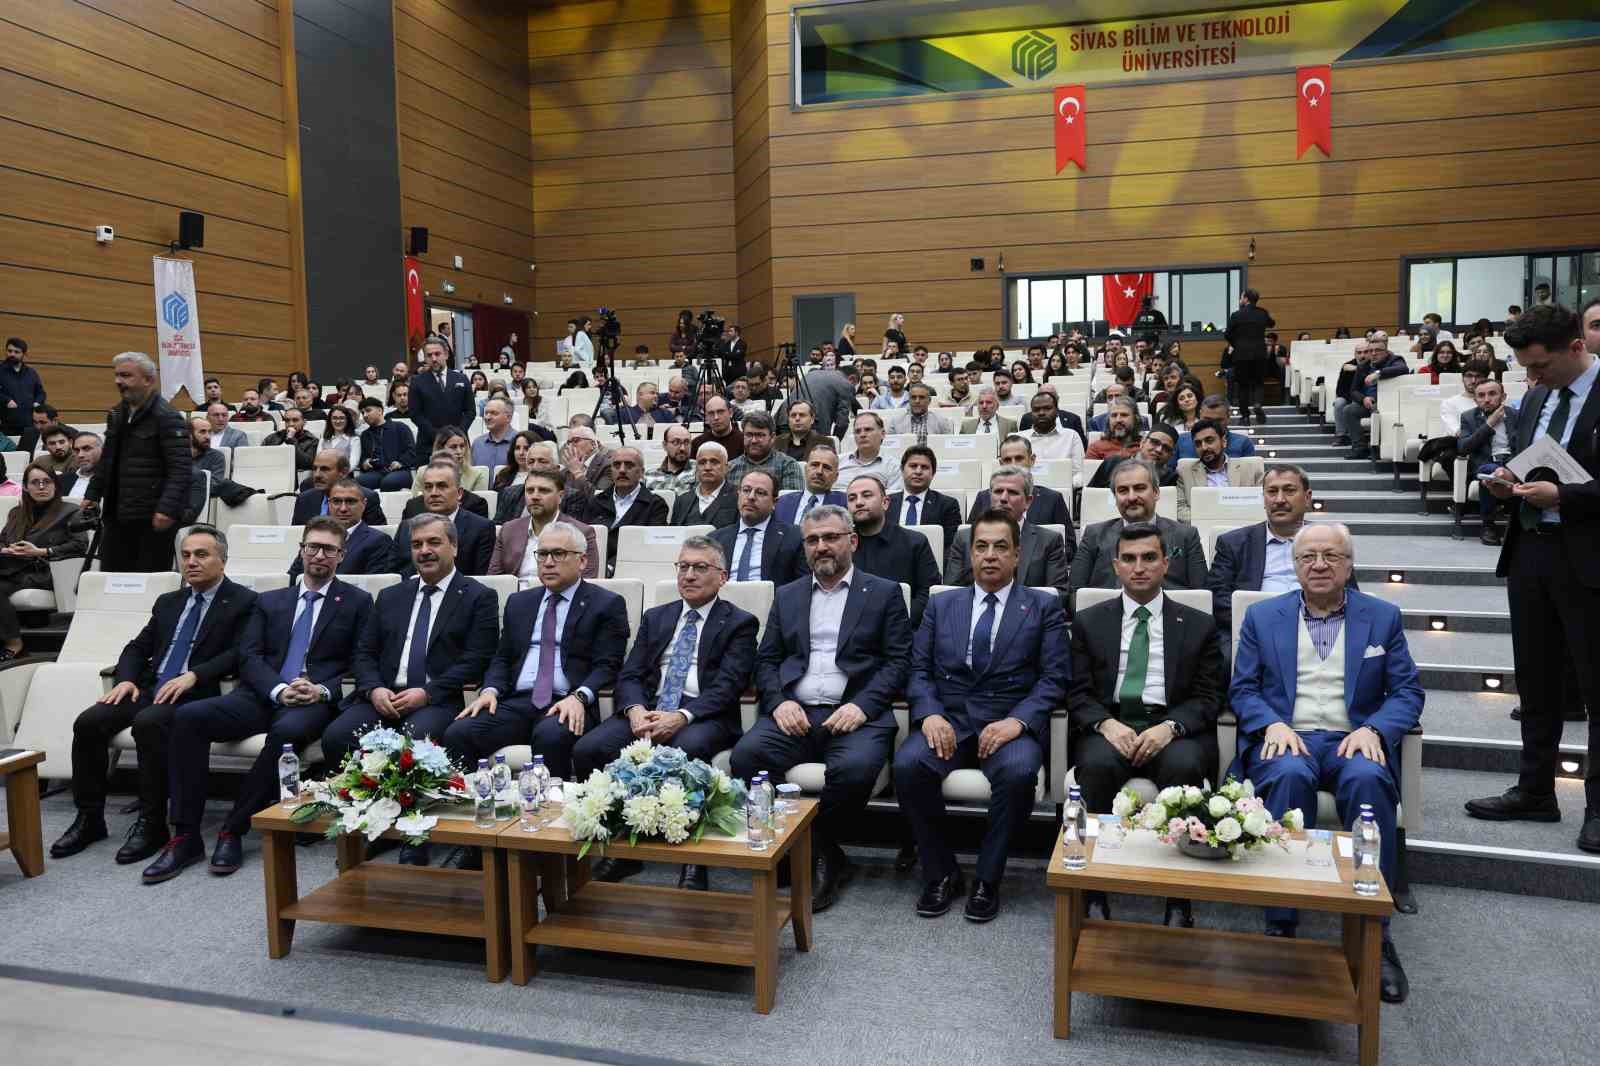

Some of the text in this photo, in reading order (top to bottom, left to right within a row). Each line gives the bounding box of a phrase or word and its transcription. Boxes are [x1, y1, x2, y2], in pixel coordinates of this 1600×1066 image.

[1070, 11, 1290, 51] SİVAS BİLİM VE TEKNOLOJİ
[1122, 42, 1236, 72] ÜNİVERSİTESİ
